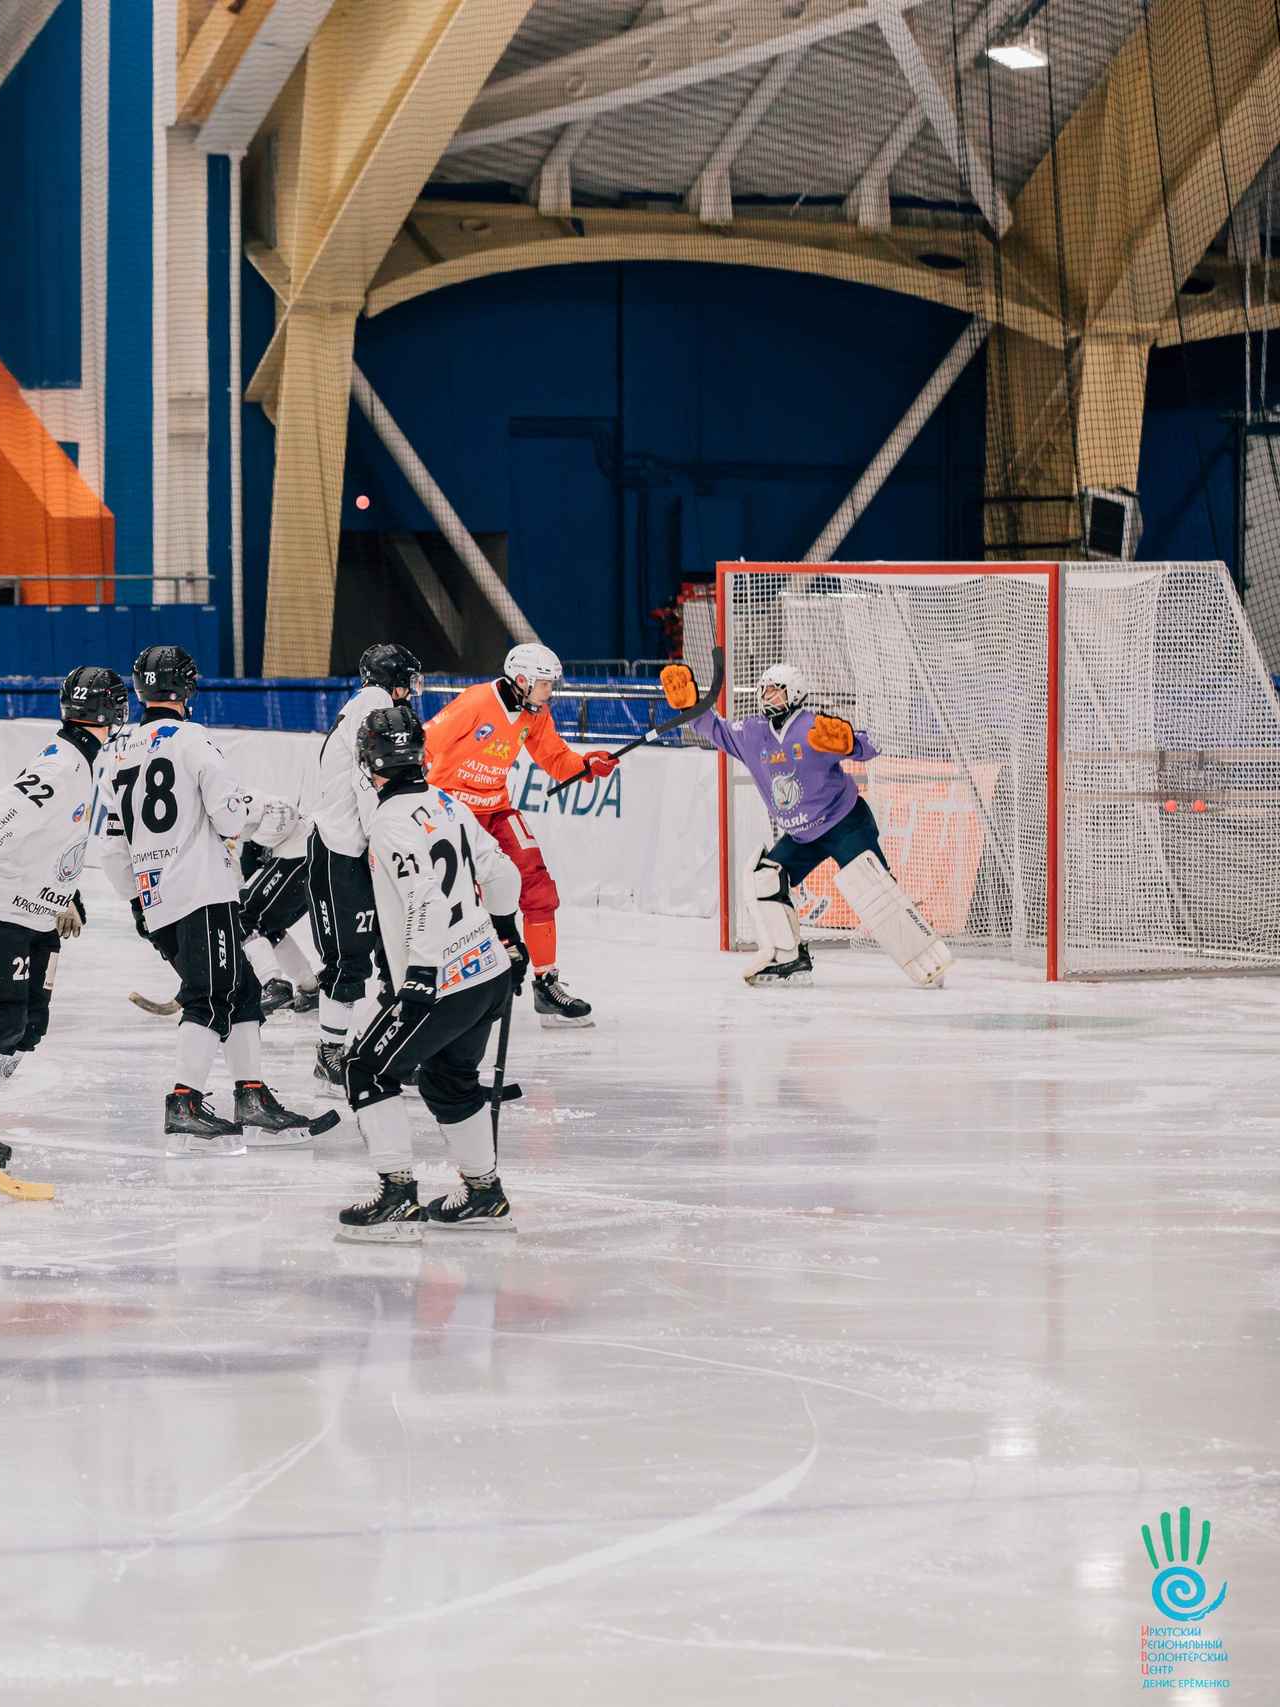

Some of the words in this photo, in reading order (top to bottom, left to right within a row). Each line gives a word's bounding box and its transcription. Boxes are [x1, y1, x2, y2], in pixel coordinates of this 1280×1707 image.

[144, 672, 156, 685] 78
[73, 687, 87, 699] 22
[394, 732, 410, 744] 21
[14, 774, 54, 808] 22
[112, 757, 178, 845] 78
[391, 852, 420, 879] 21
[429, 824, 479, 928] 21
[262, 870, 283, 897] STEX
[319, 899, 331, 936] STEX
[355, 910, 375, 933] 27
[218, 928, 228, 970] STEX
[373, 1016, 405, 1056] STEX
[387, 1199, 412, 1222] CCM
